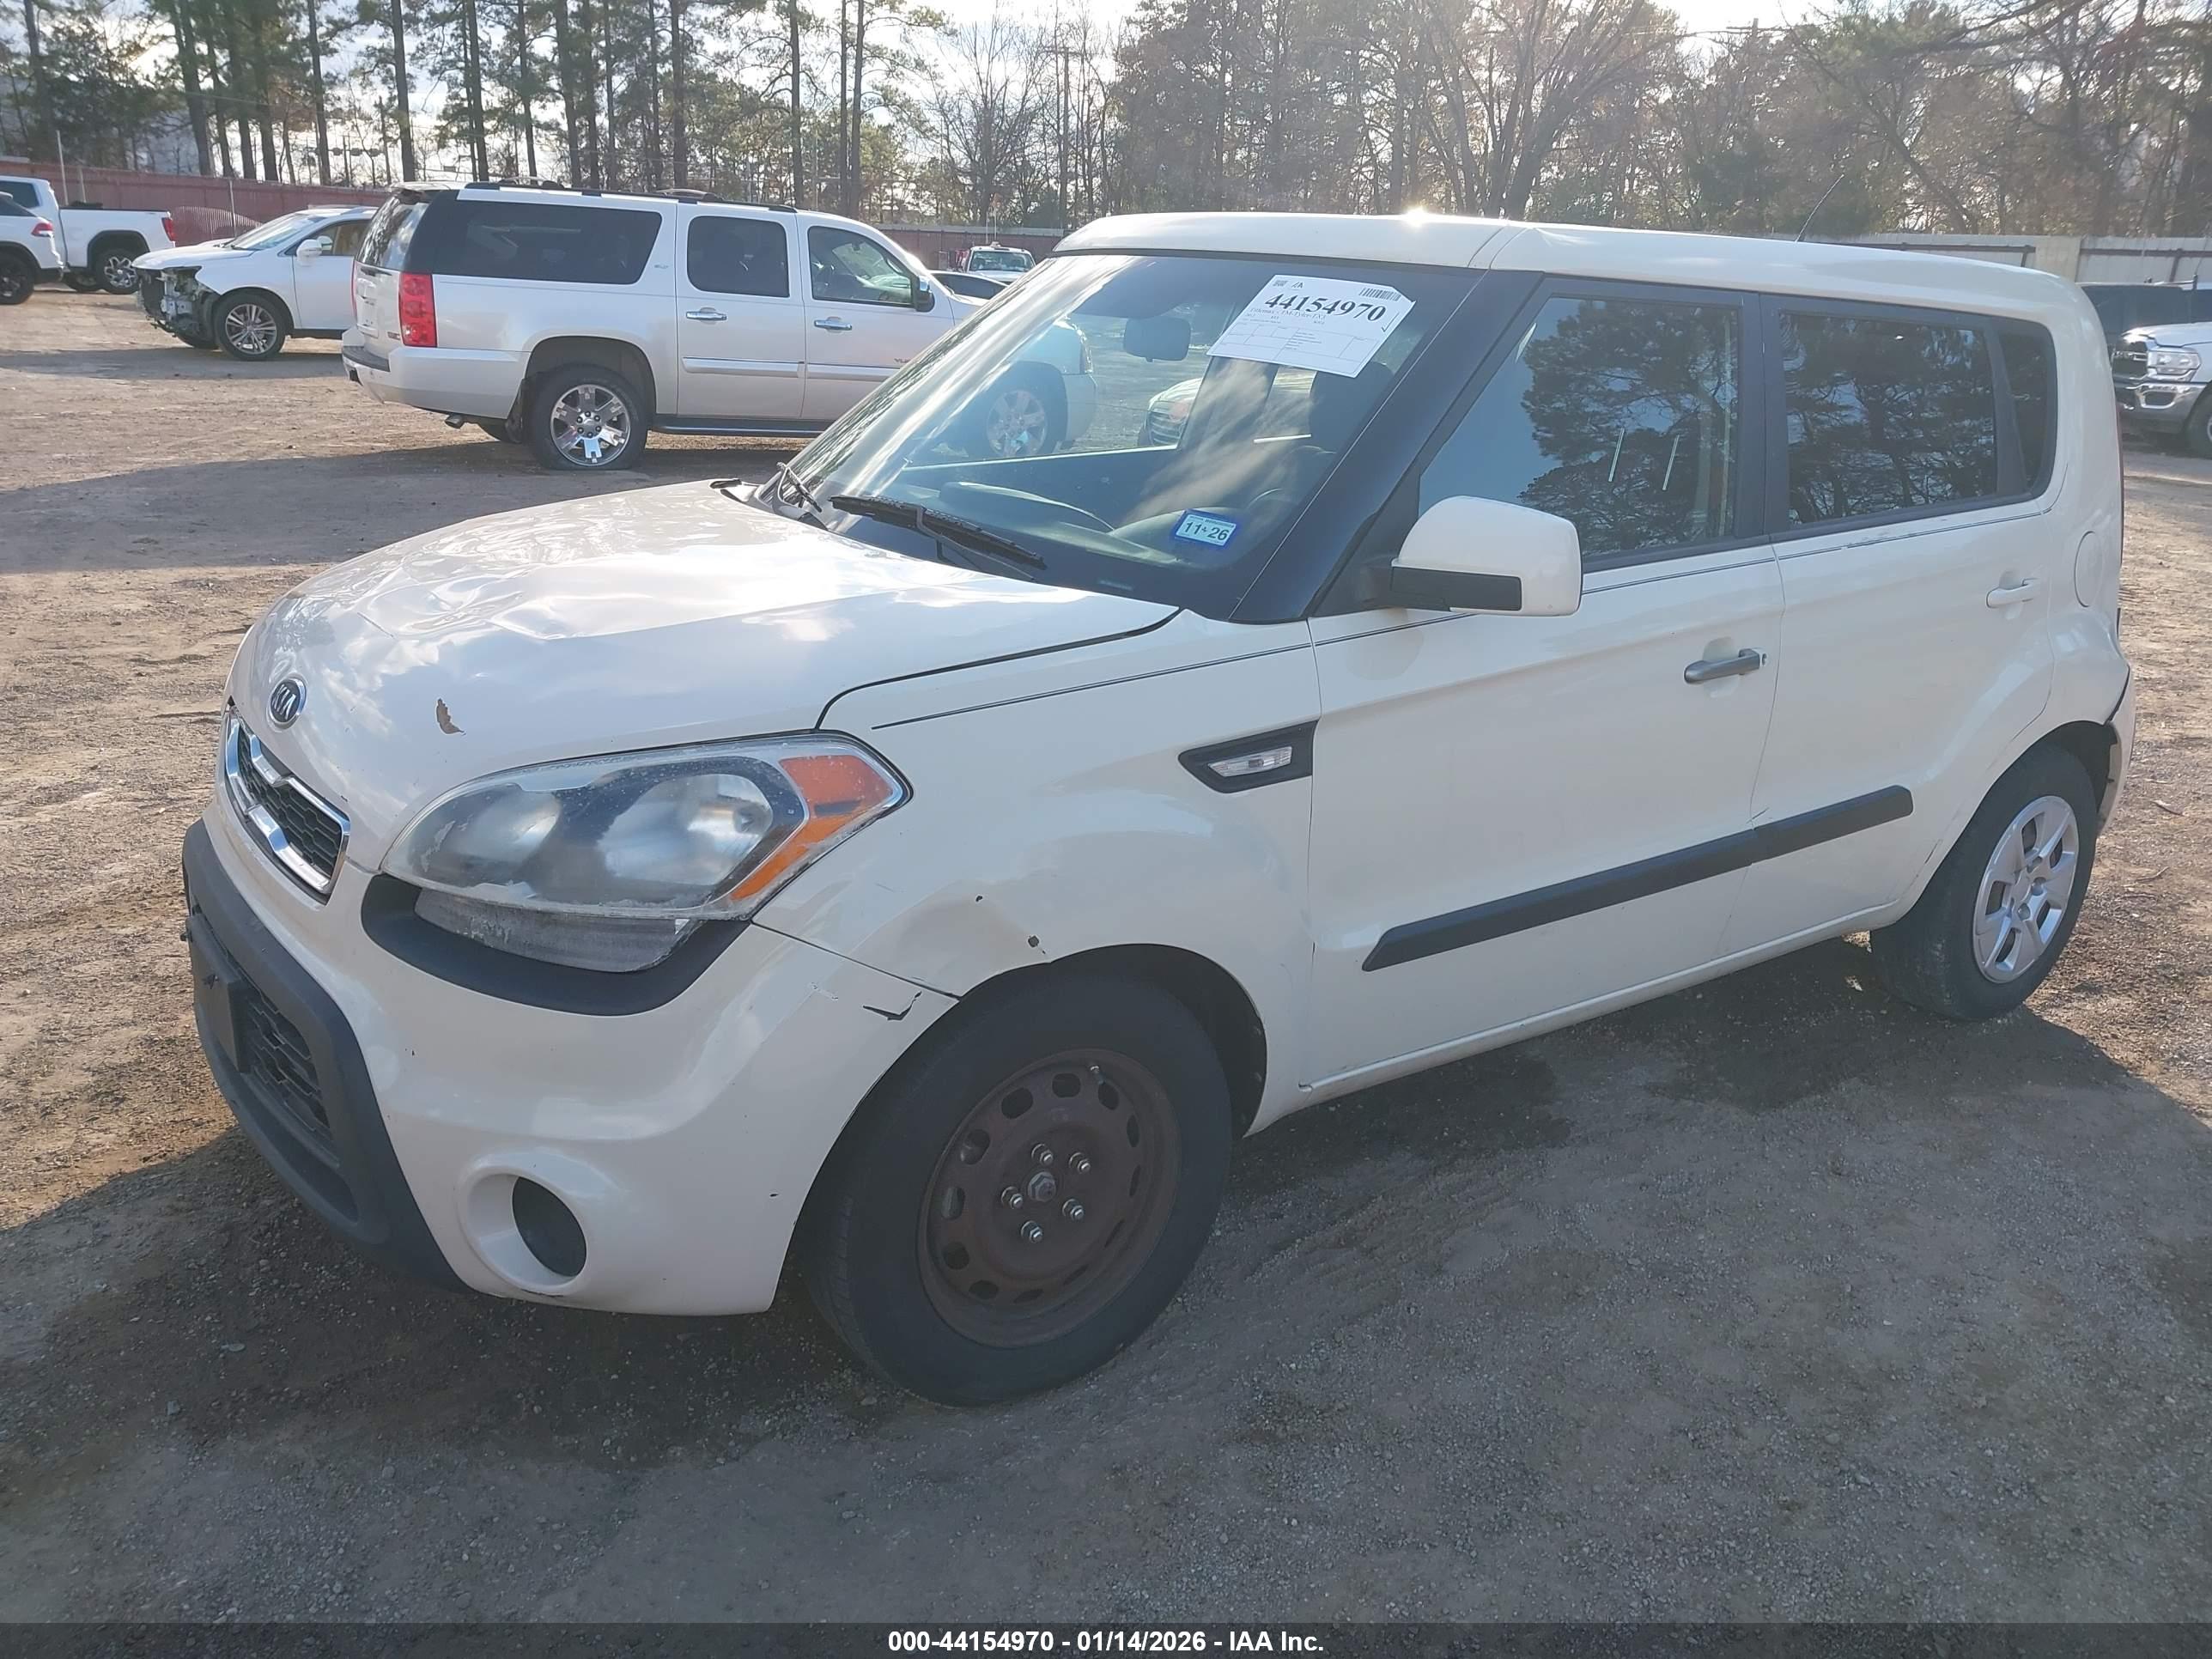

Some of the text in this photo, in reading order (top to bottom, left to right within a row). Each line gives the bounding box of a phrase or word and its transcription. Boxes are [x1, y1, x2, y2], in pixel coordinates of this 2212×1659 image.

[1265, 294, 1386, 321] 44154970
[1185, 521, 1202, 535] 11
[1207, 527, 1230, 540] 26
[272, 684, 296, 720] KIA
